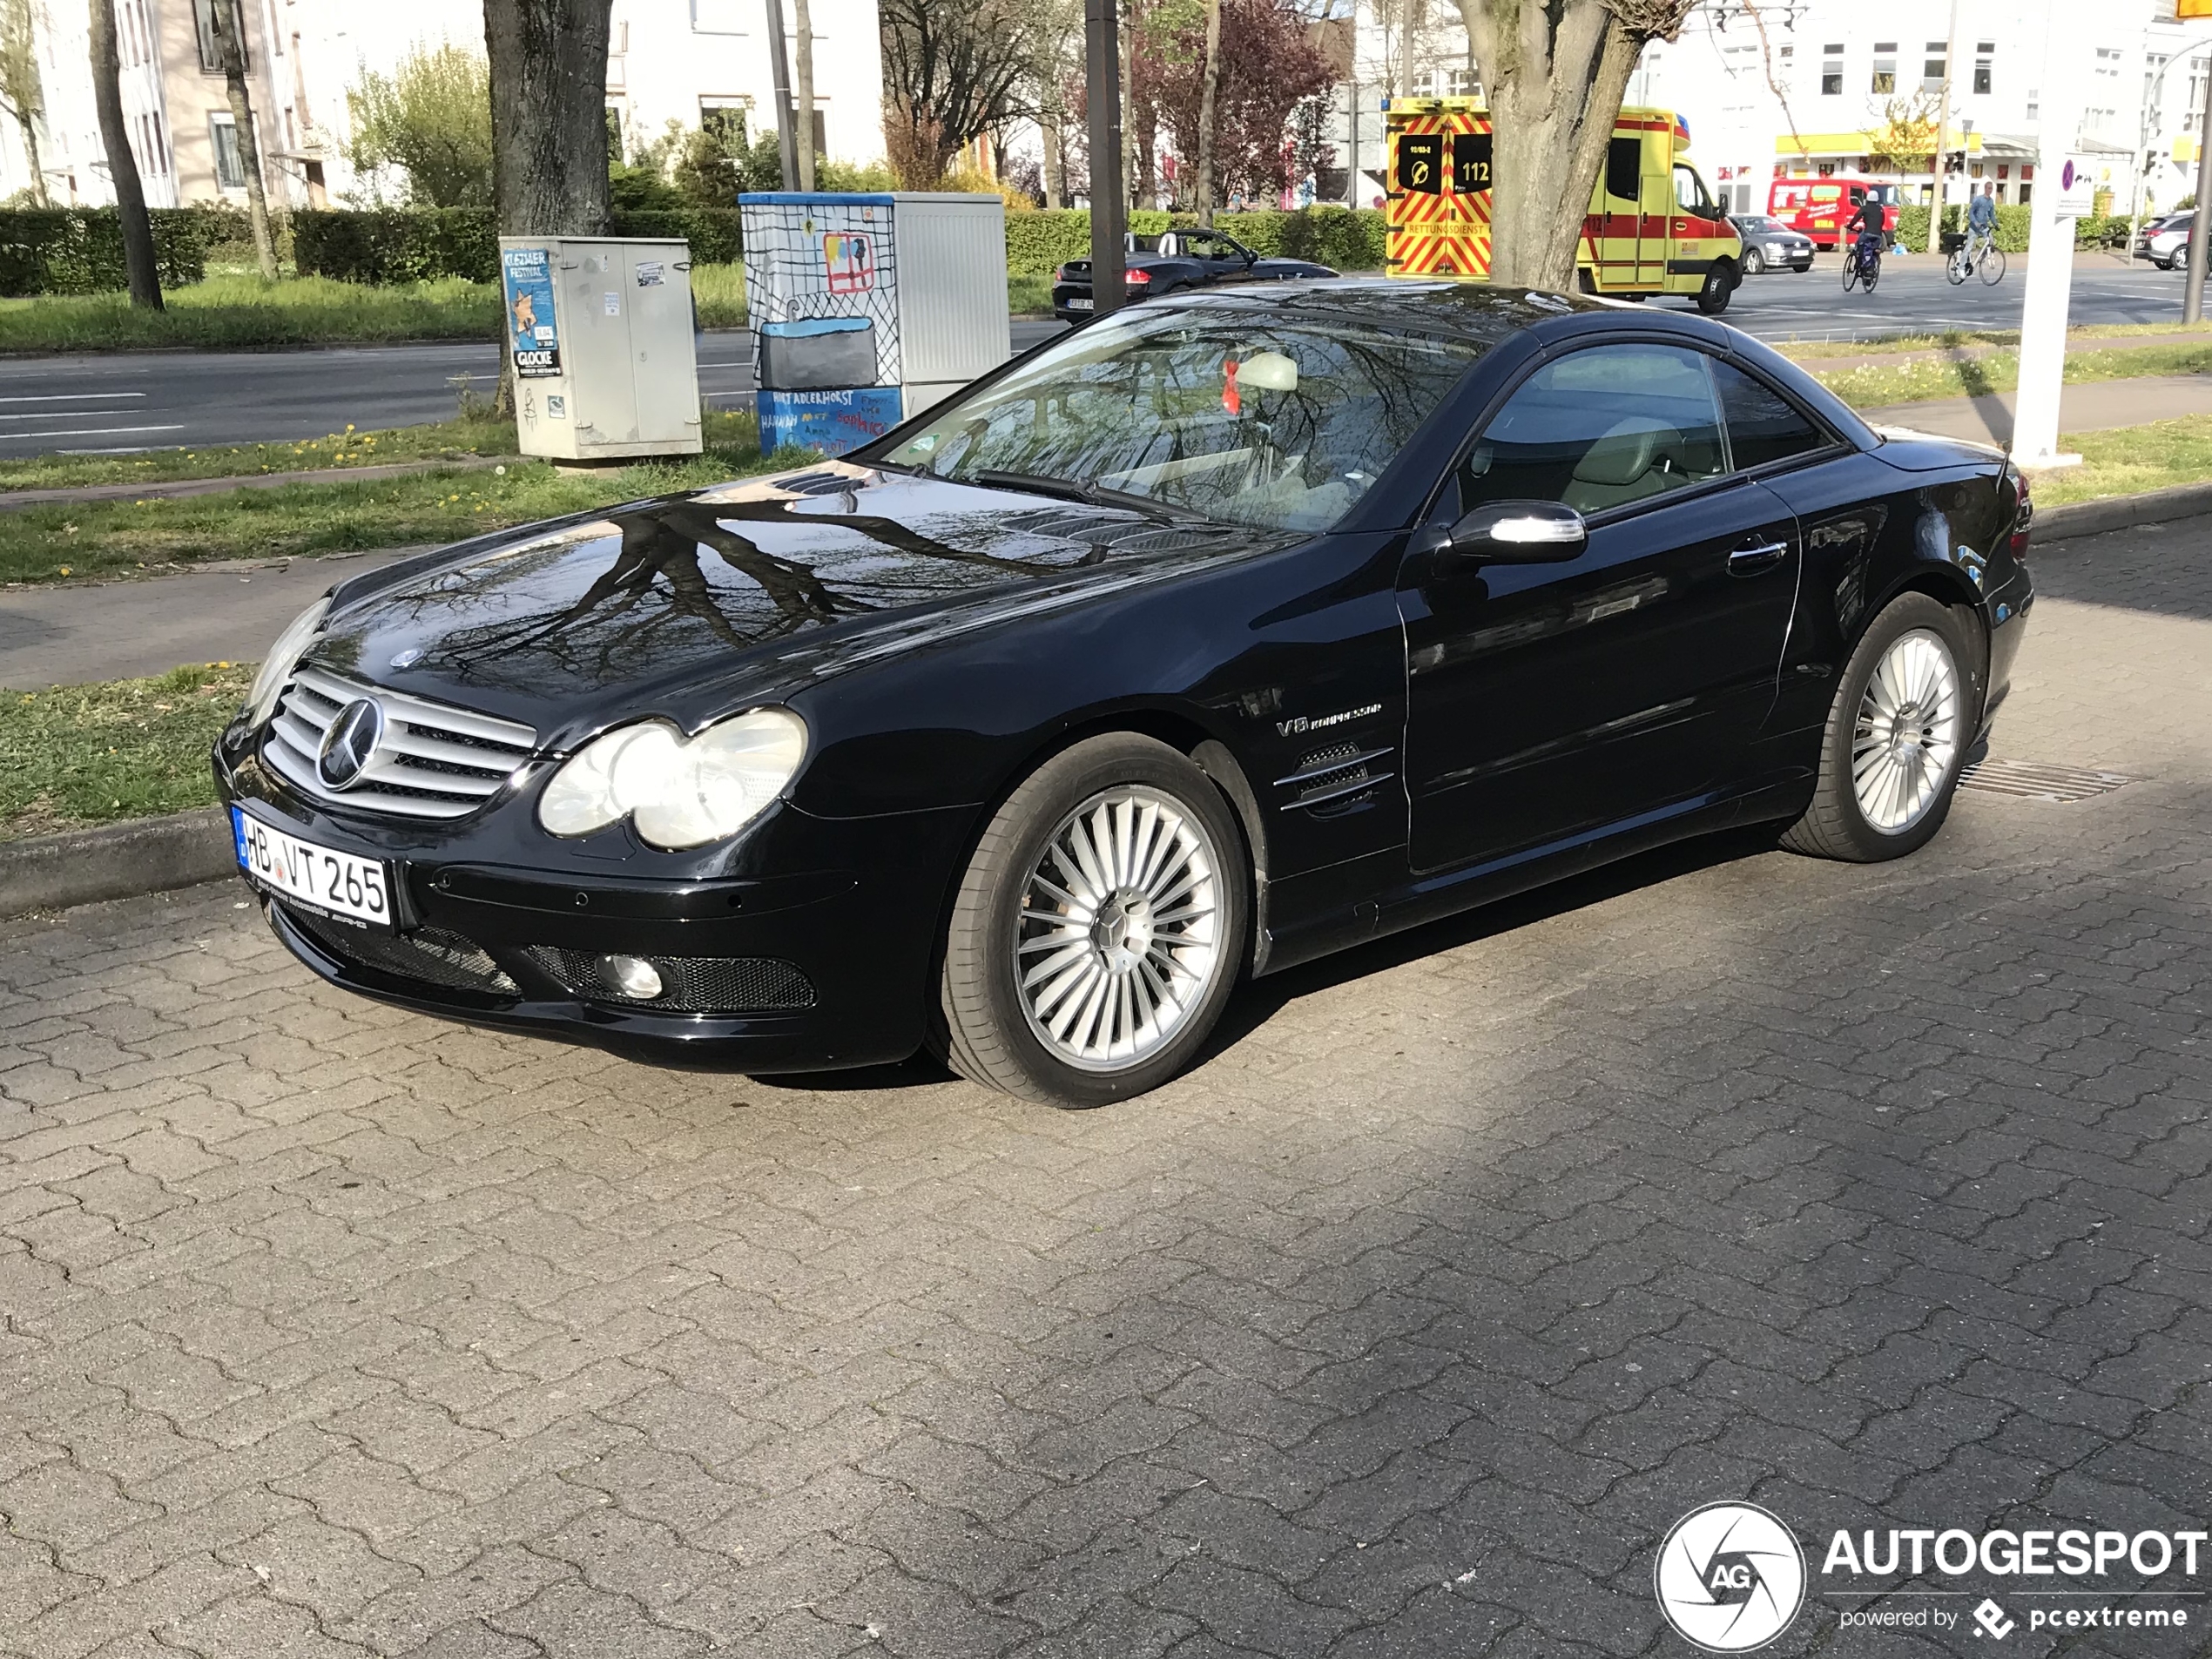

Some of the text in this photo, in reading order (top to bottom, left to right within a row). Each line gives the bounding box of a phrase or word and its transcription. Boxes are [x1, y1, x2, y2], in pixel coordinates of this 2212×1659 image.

[1463, 162, 1489, 181] 112
[1409, 224, 1485, 235] RETTUNGSDIENST
[504, 252, 546, 266] KLEZMER
[509, 266, 543, 278] FESTIVAL
[517, 350, 553, 366] GLOCKE
[793, 391, 853, 406] ADLERHORST
[1276, 716, 1309, 738] V8
[244, 819, 385, 914] HB VT 265
